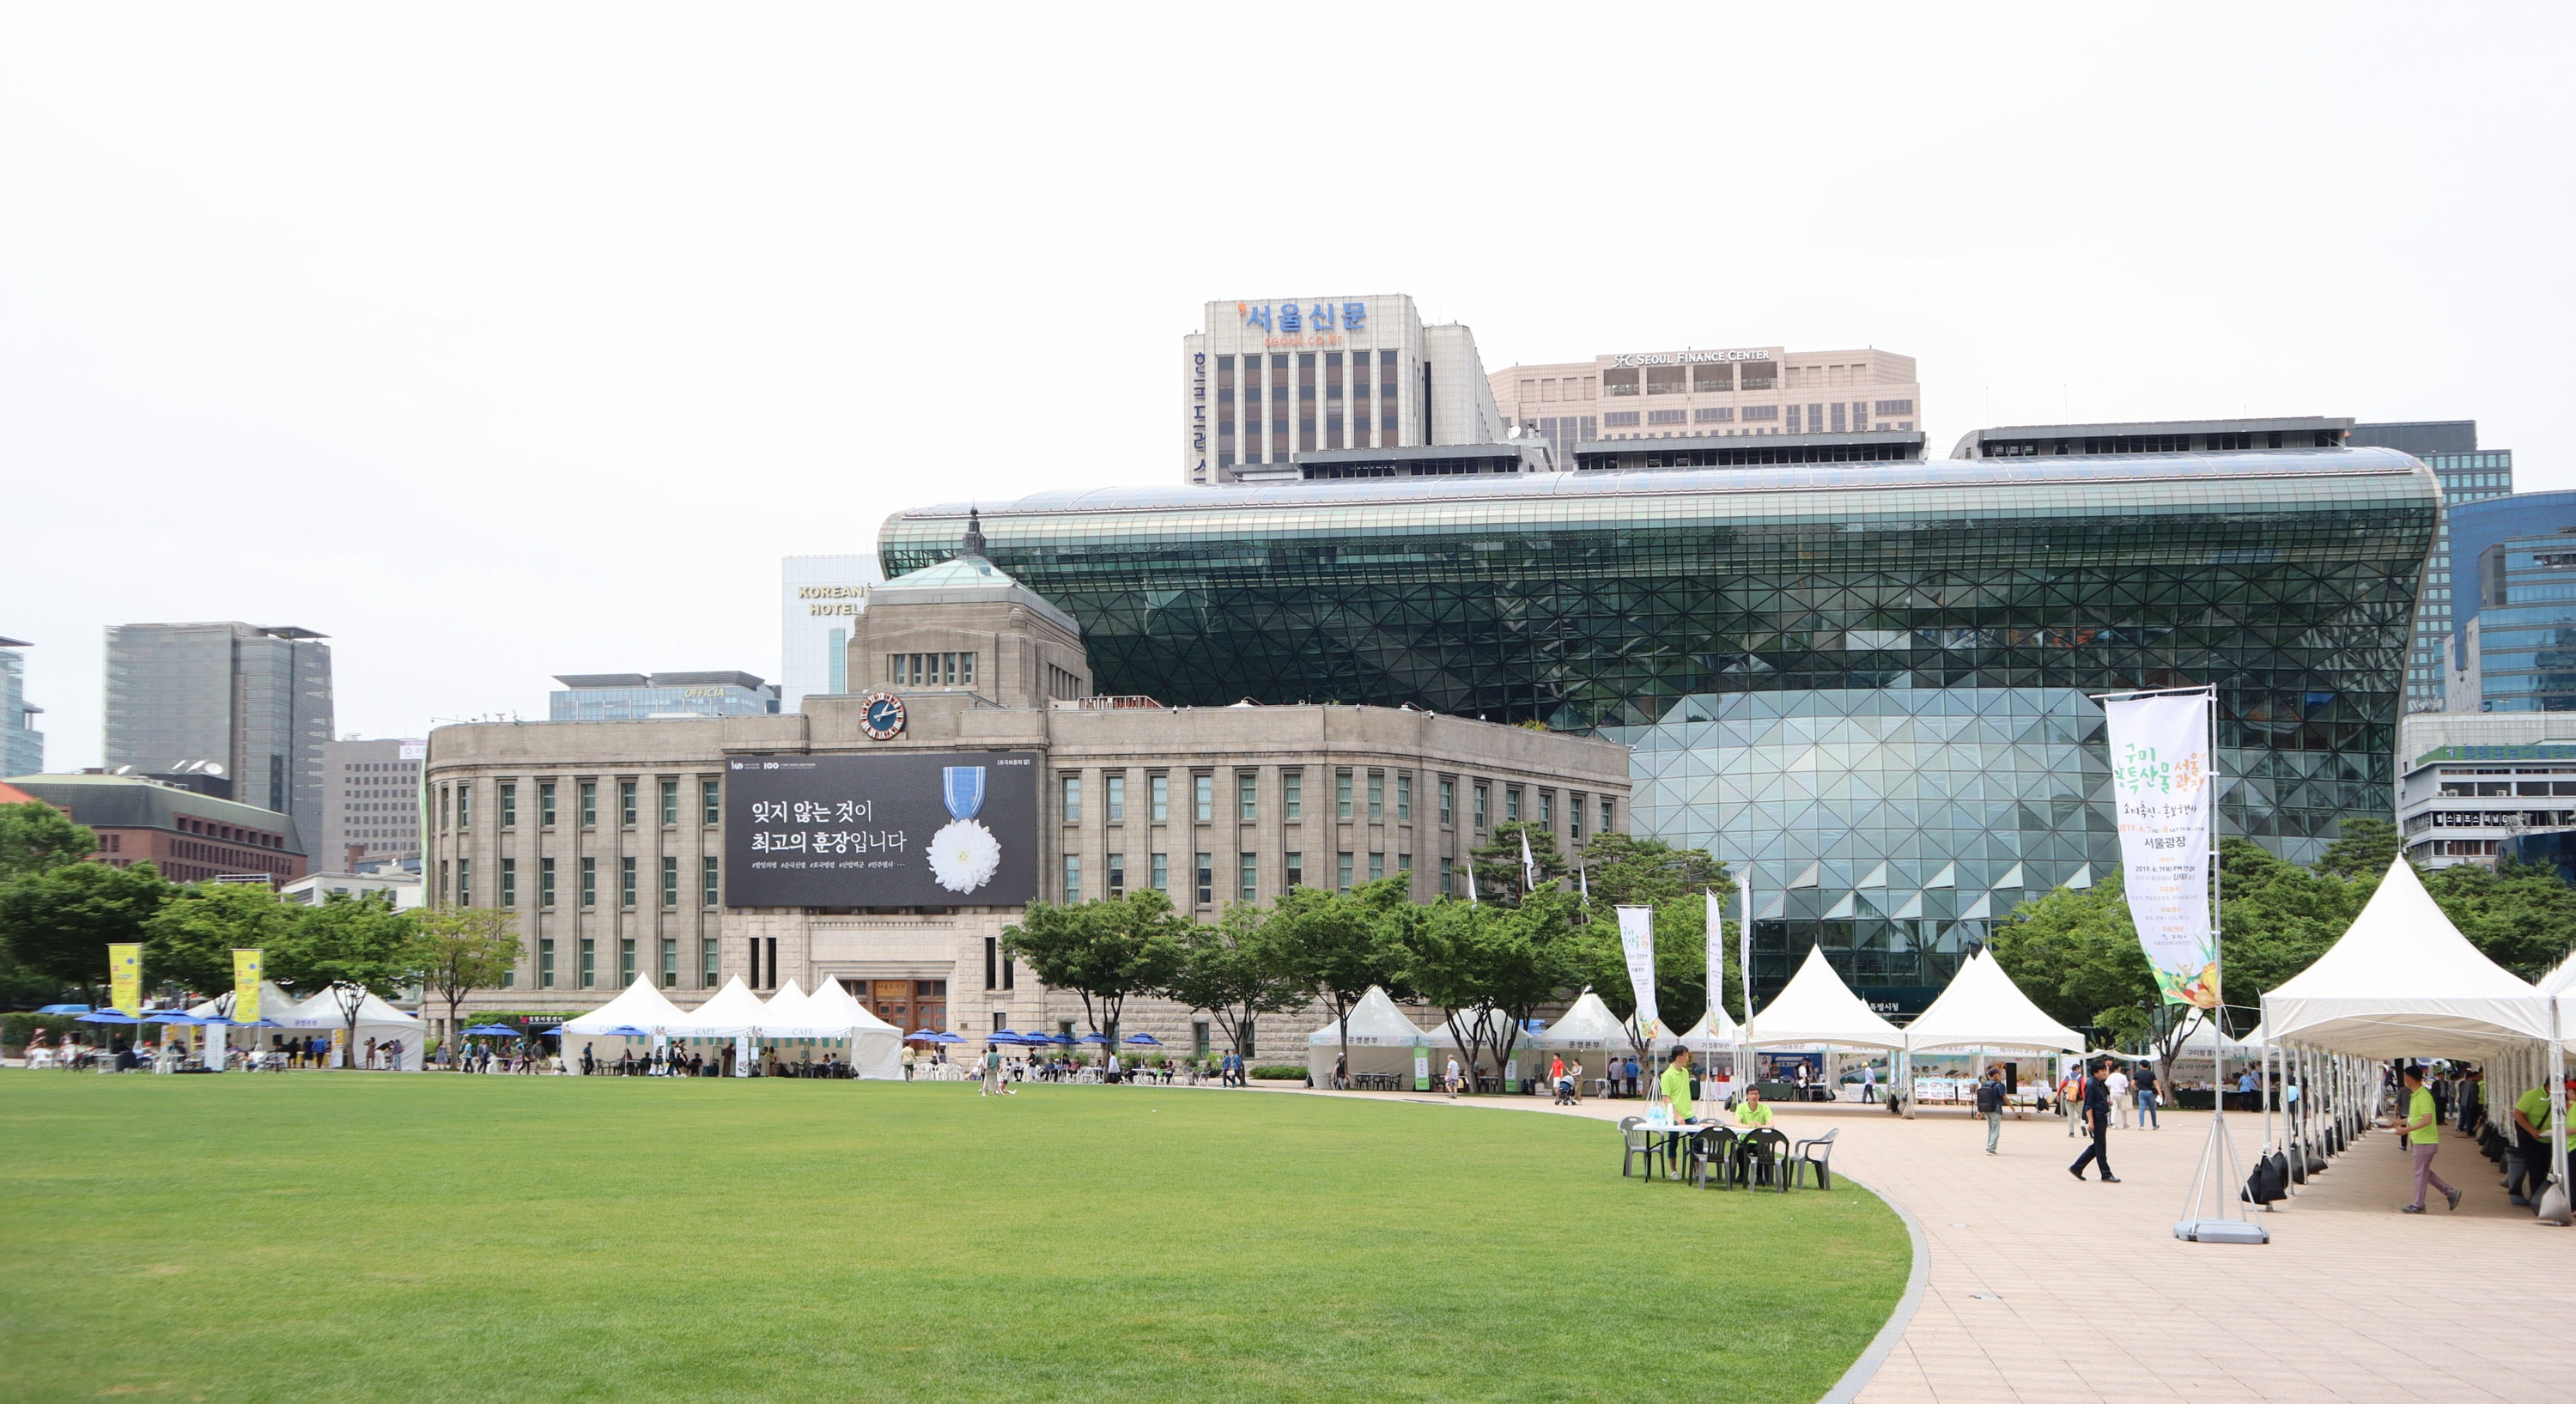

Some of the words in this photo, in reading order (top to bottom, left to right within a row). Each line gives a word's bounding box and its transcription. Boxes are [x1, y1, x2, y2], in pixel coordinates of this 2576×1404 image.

[1247, 302, 1367, 332] 서울신문
[1264, 333, 1343, 348] seoul.co.kr
[1637, 354, 1674, 366] SEOUL
[1677, 351, 1725, 363] FINANCE
[1728, 349, 1770, 362] CENTER
[799, 586, 867, 599] KOREAN
[810, 604, 861, 616] HOTEL
[2125, 743, 2156, 763] 구미
[2175, 752, 2199, 777] 서울
[2175, 774, 2204, 793] 광장
[751, 801, 787, 824] 잊지
[793, 801, 832, 824] 않는
[836, 800, 872, 824] 것이
[751, 830, 807, 854] 최고의
[811, 830, 907, 854] 훈장입니다
[2144, 836, 2186, 849] 서울광장
[1569, 1041, 1600, 1049] 운영본부
